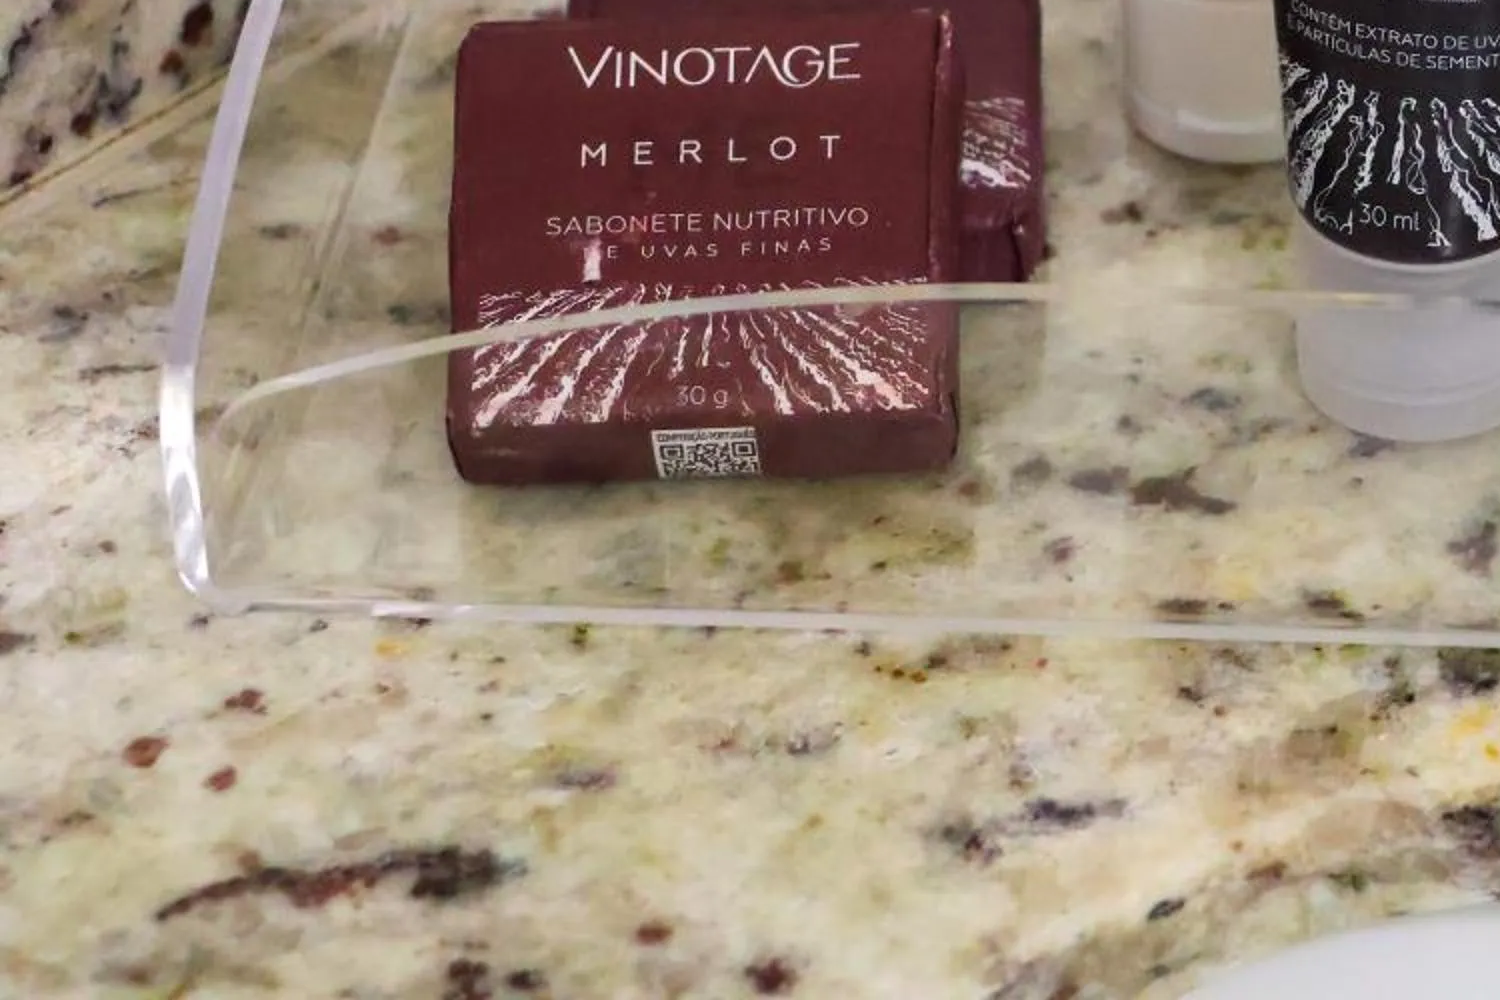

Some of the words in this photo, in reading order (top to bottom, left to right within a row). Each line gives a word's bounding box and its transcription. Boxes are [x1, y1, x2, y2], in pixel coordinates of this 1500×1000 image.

[1296, 20, 1392, 65] PARTÍCULAS
[1395, 51, 1421, 69] DE
[1354, 22, 1439, 50] EXTRATO
[1443, 34, 1470, 51] DE
[567, 42, 862, 89] VINOTAGE
[581, 134, 842, 168] MERLOT
[545, 213, 703, 237] SABONETE
[712, 206, 870, 232] NUTRITIVO
[1358, 202, 1388, 229] 30
[1392, 207, 1421, 233] ml
[640, 243, 719, 259] UVAS
[740, 236, 833, 257] FINAS
[675, 385, 707, 407] 30
[713, 389, 729, 410] g
